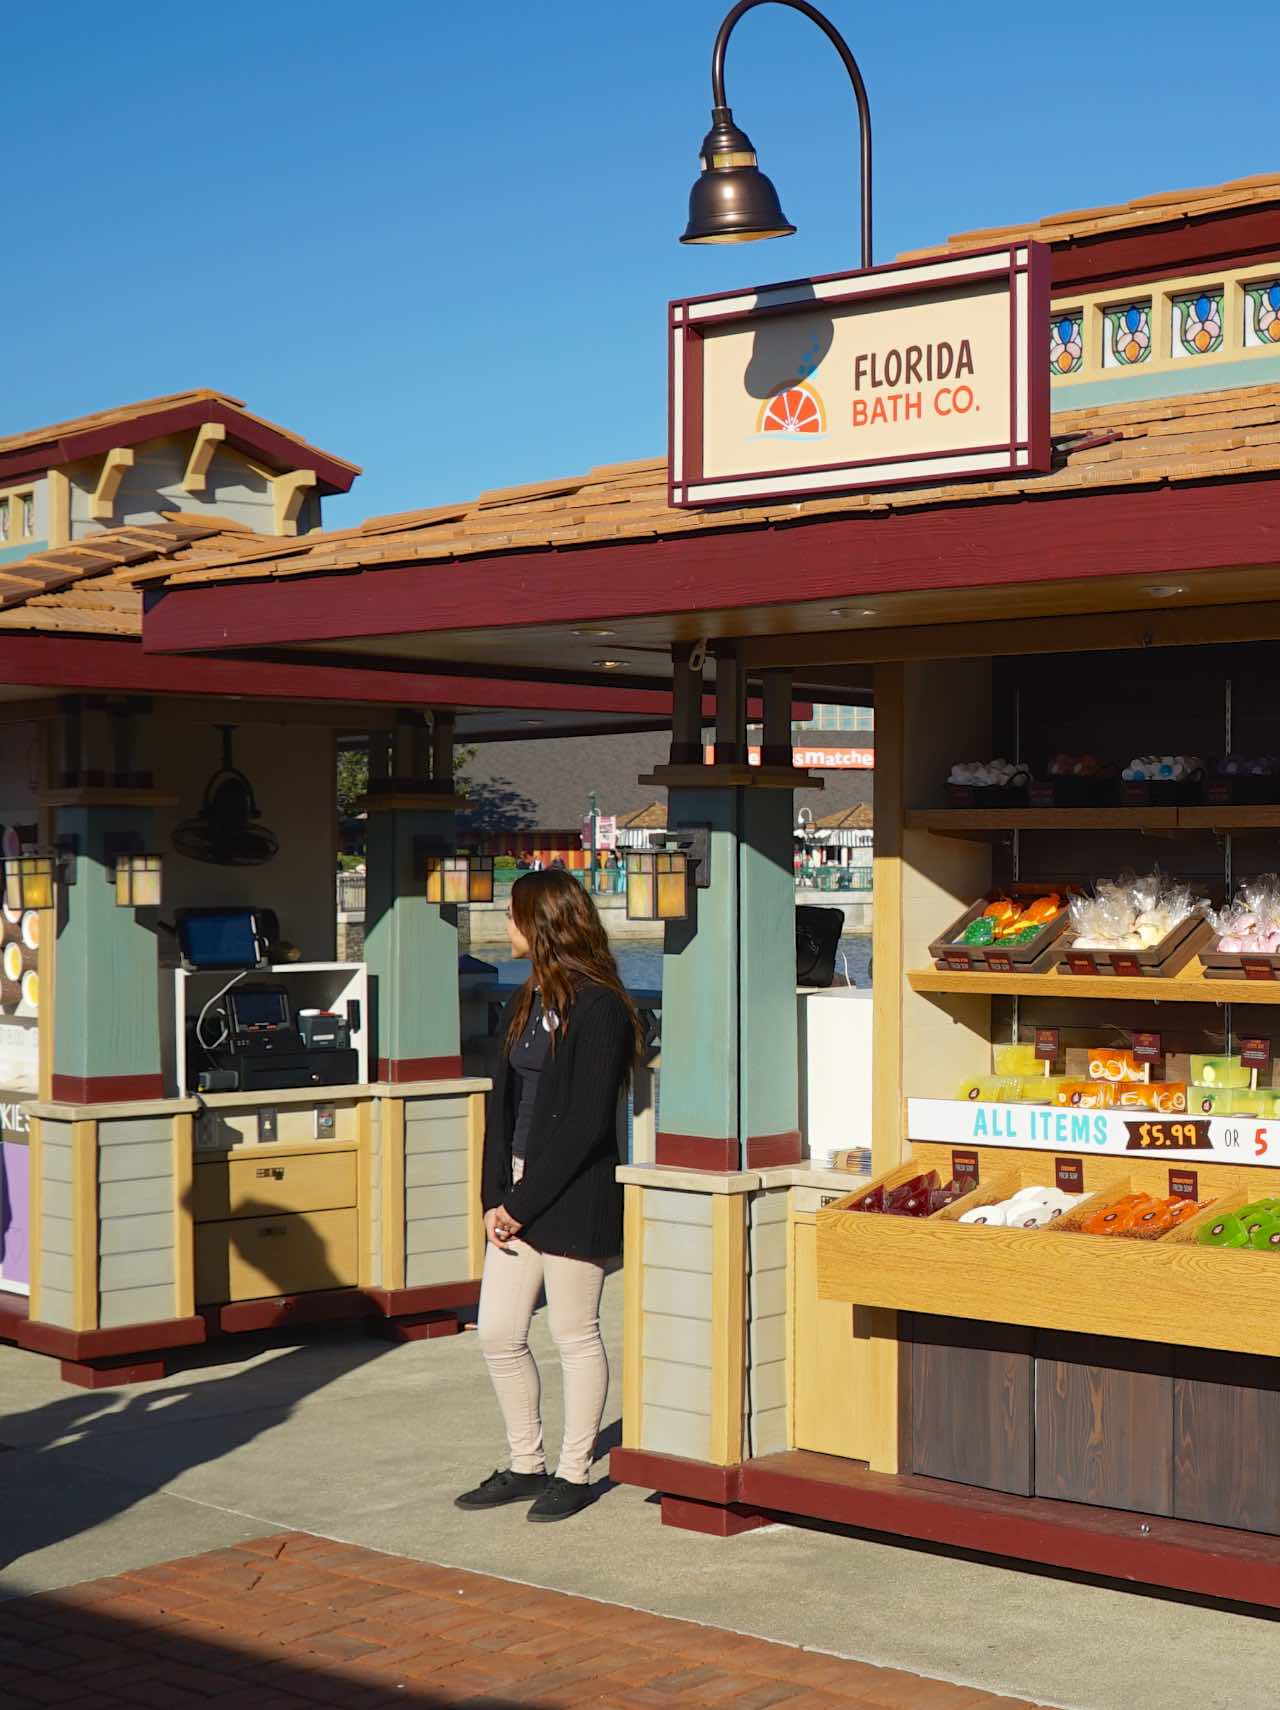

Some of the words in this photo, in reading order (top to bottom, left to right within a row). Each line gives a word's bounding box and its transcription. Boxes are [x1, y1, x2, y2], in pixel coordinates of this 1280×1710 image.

[854, 339, 974, 391] FLORIDA
[852, 392, 922, 427] BATH
[934, 385, 980, 416] CO.
[973, 1108, 1017, 1138] ALL
[1030, 1111, 1108, 1145] ITEMS
[1139, 1122, 1196, 1147] $5.99
[1225, 1129, 1240, 1148] OR
[1255, 1128, 1268, 1156] 5
